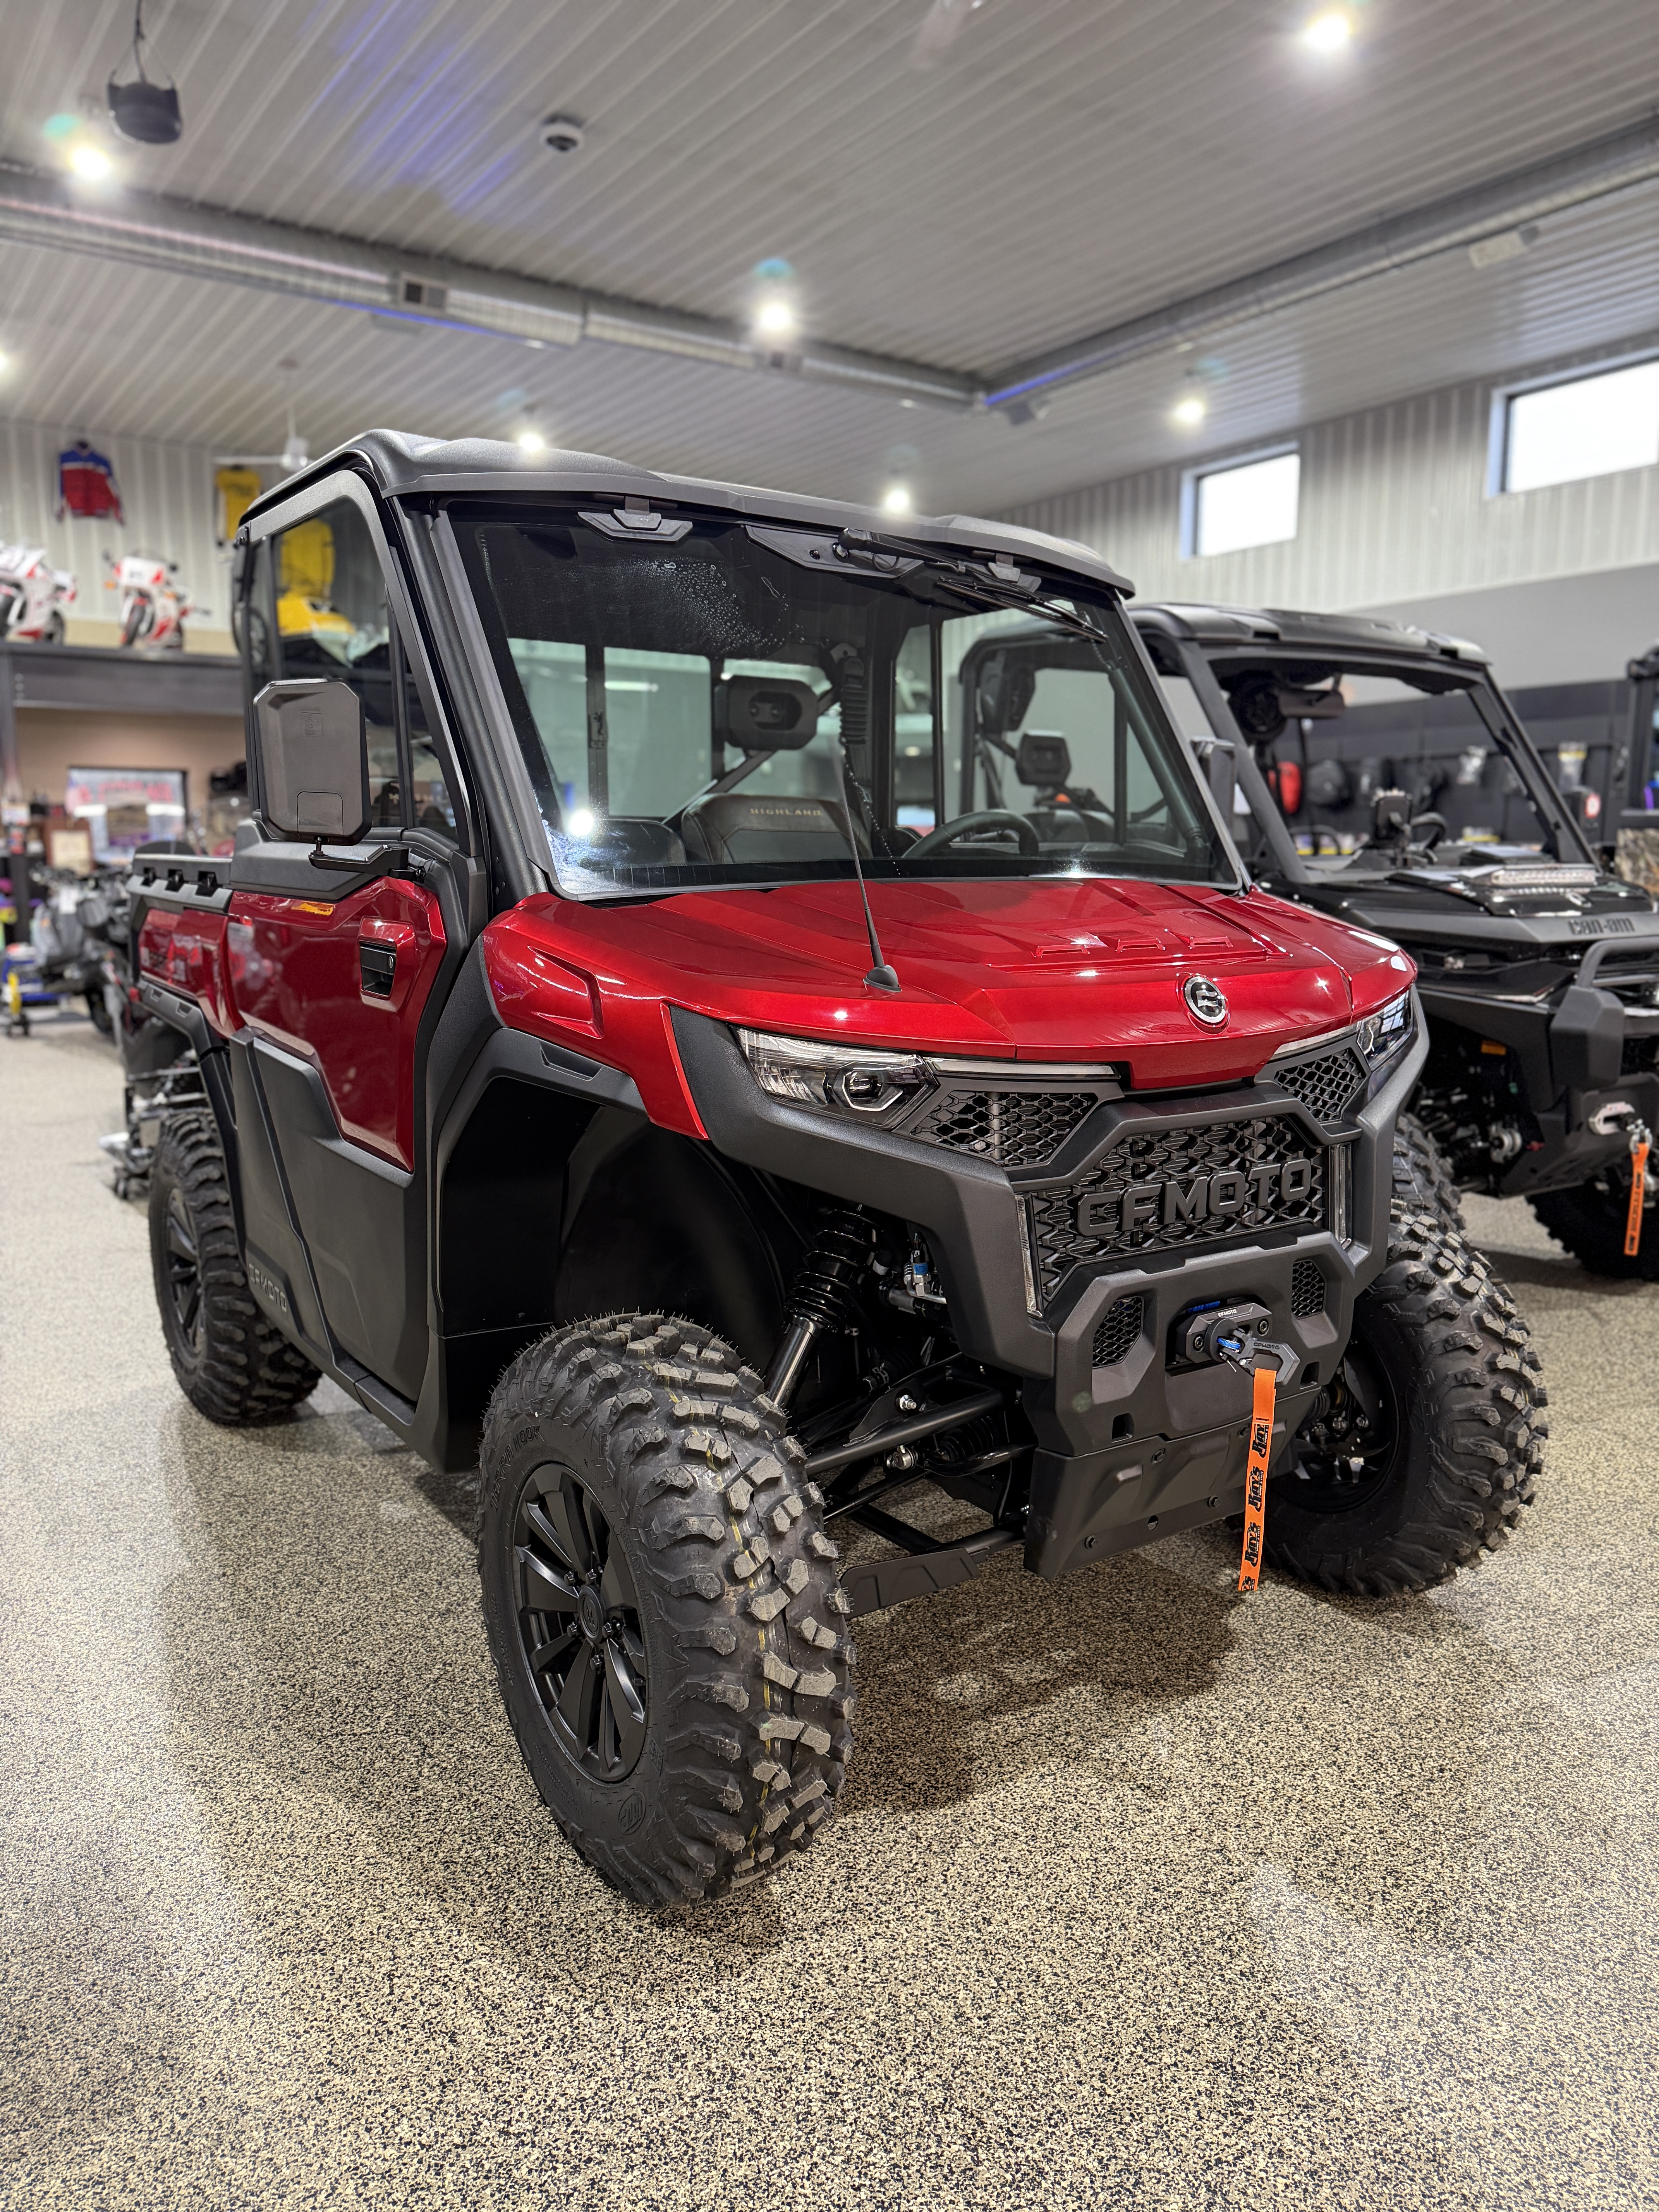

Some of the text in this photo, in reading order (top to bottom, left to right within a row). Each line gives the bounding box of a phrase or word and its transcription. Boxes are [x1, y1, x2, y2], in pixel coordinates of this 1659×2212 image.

[750, 807, 821, 816] HIGHLAND
[1077, 1158, 1311, 1236] CFMOTO
[249, 1263, 287, 1312] CFMOTO
[1218, 1309, 1237, 1317] CFMOTO
[1253, 1342, 1280, 1350] CFMOTO
[490, 1425, 544, 1511] TERRA HOOK
